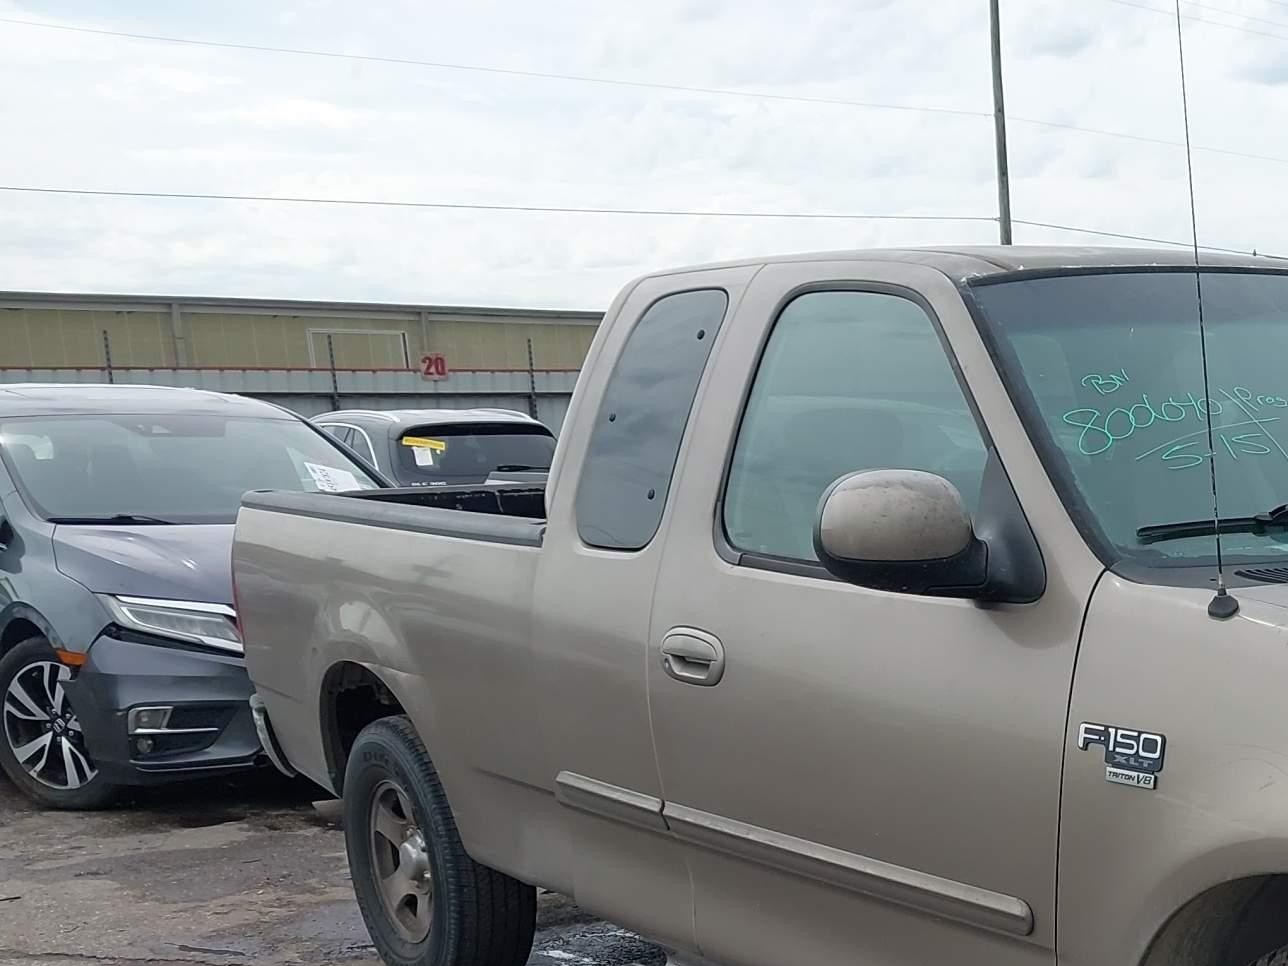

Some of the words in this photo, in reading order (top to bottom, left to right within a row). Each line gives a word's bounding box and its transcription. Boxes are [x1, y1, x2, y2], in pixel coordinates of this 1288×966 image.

[421, 356, 446, 376] 20
[1113, 755, 1153, 767] XLT
[1107, 771, 1135, 782] TRITON
[1136, 774, 1152, 785] V8
